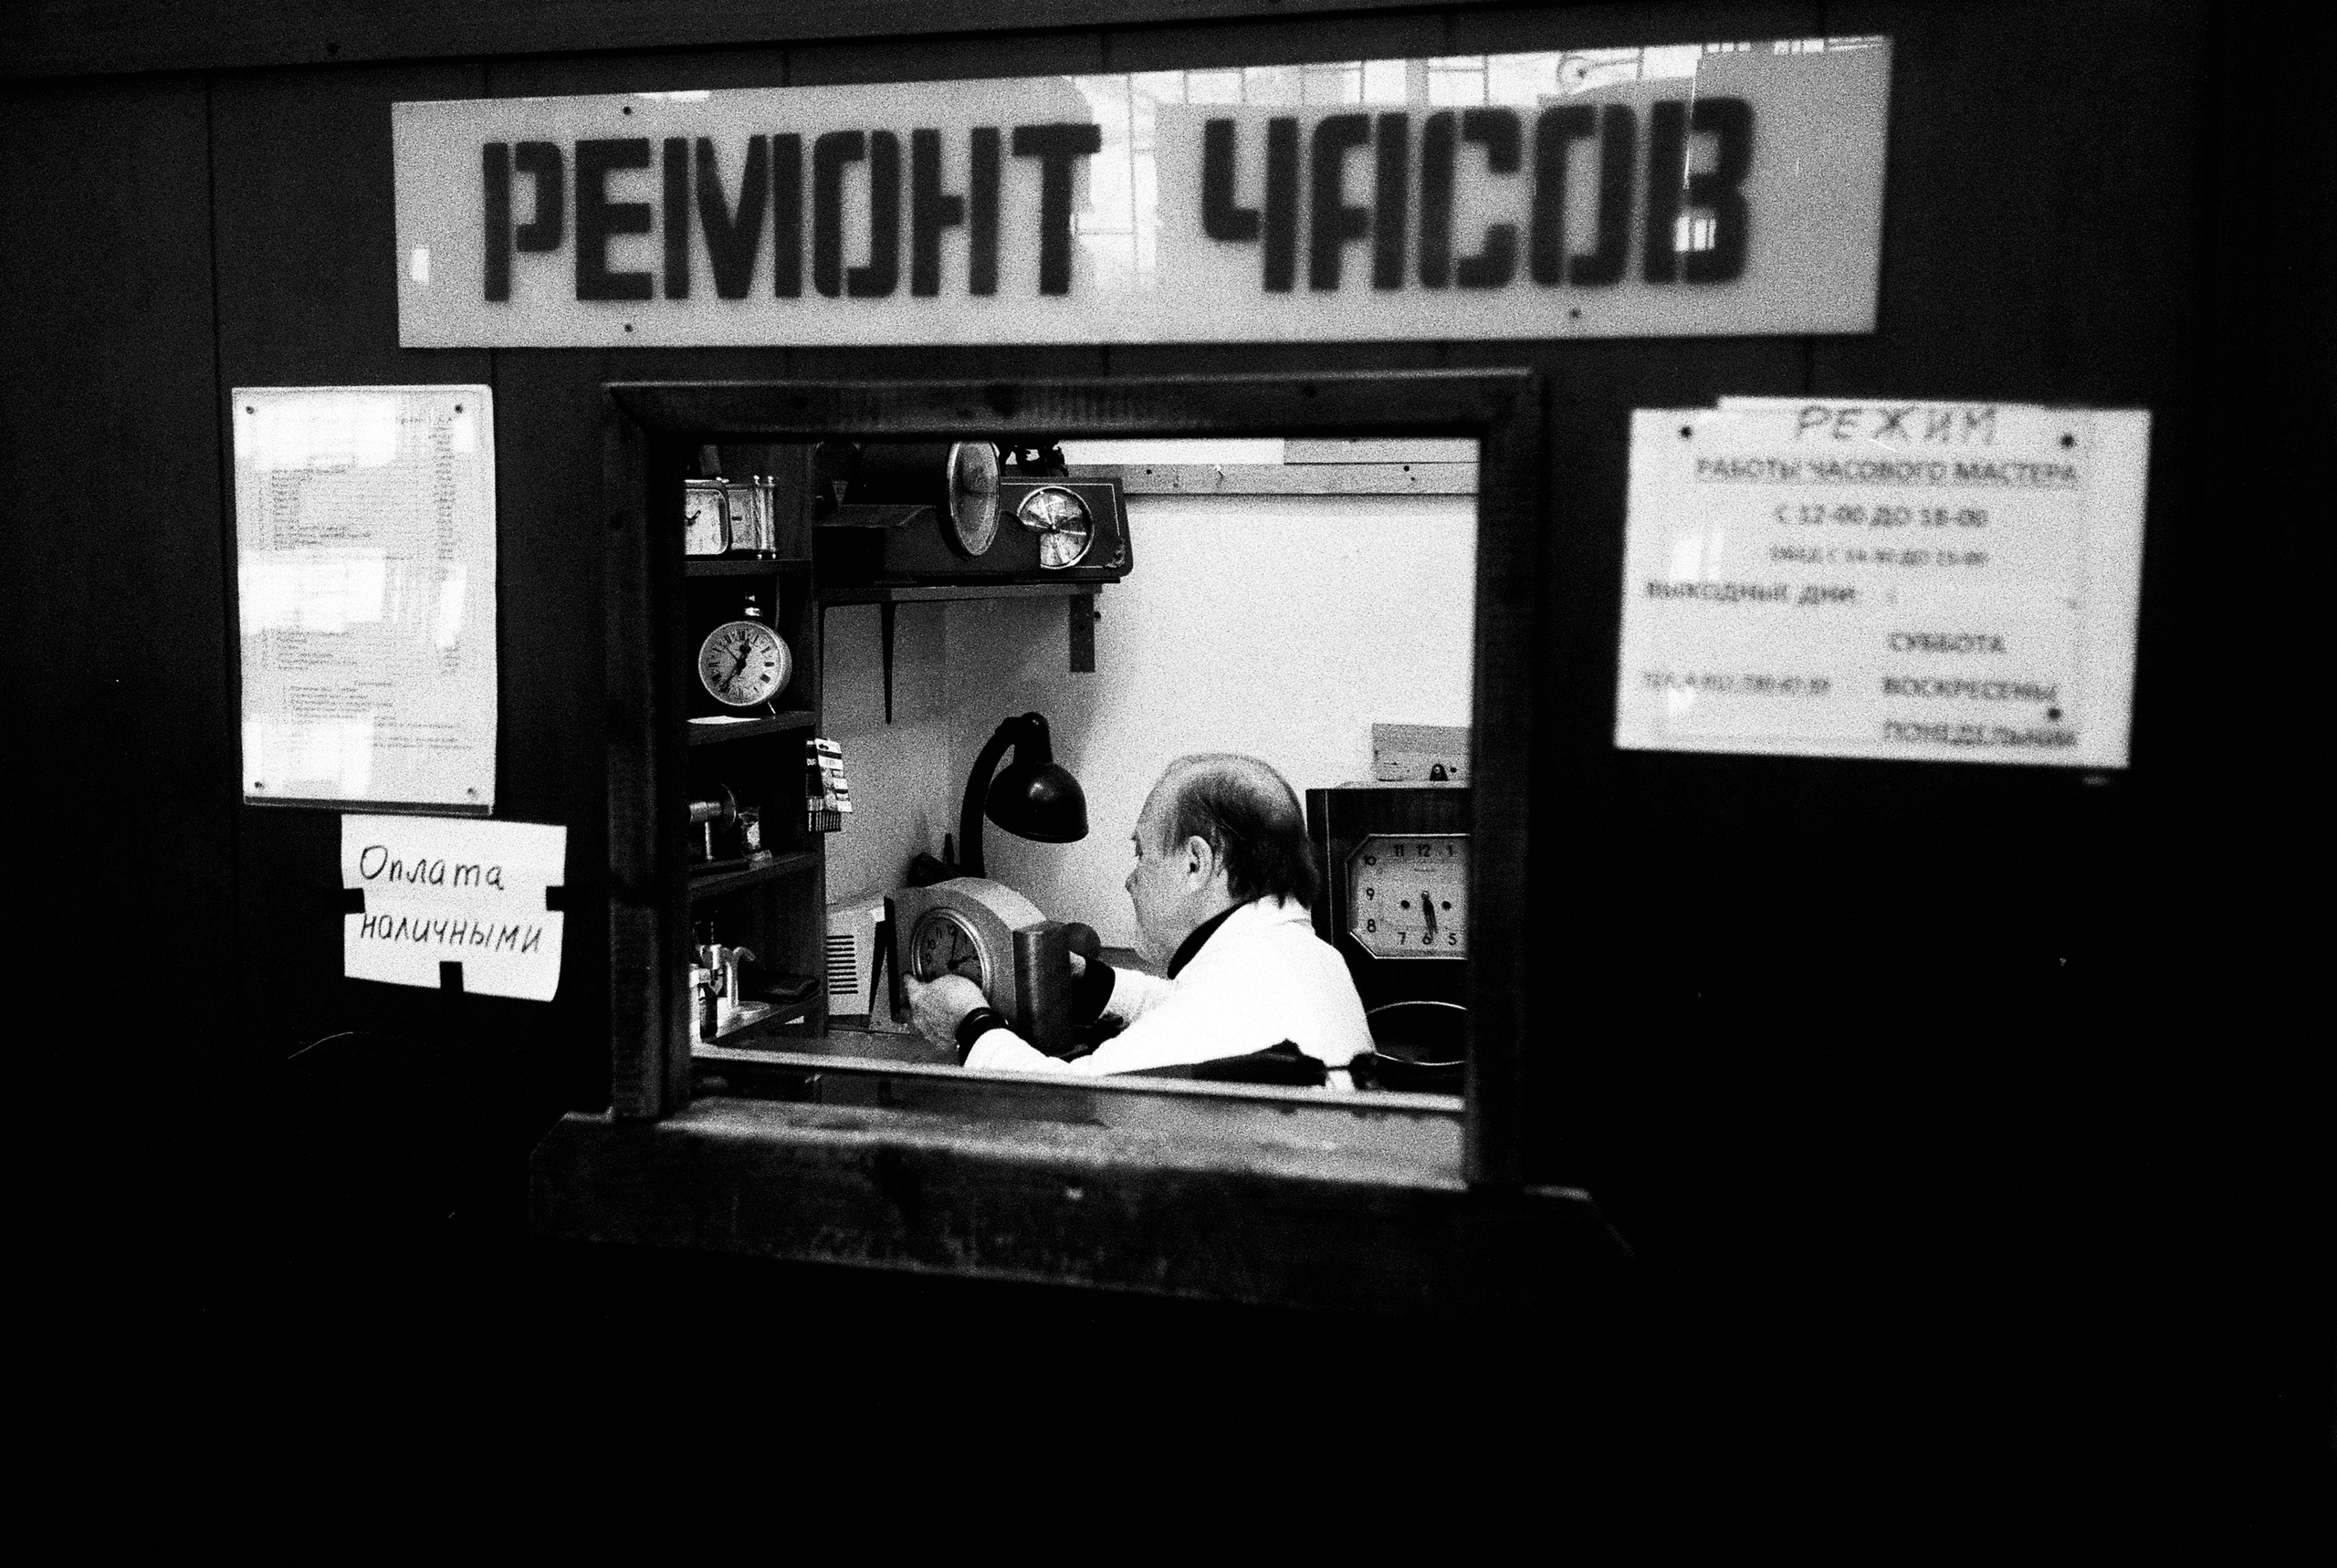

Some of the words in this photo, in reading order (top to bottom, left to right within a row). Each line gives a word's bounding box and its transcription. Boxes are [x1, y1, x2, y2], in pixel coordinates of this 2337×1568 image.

[482, 122, 1102, 302] РЕМОНТ
[1200, 96, 1756, 294] ЧАСОВ
[1797, 404, 1998, 444] РЕЖИМ
[1695, 457, 1800, 478] РАБОТЫ
[1807, 459, 1946, 482] ЧАСОВОГО
[1954, 461, 2078, 485] МАСТЕРА
[1869, 506, 1913, 528] ДО
[1888, 632, 2007, 654] СУББОТА
[1393, 844, 1404, 857] 11
[1416, 844, 1431, 857] 12
[360, 844, 505, 891] Оплата
[1367, 887, 1375, 901] 9
[360, 915, 543, 954] наличными
[1367, 918, 1376, 933] 8
[1398, 932, 1407, 945] 7
[1422, 932, 1431, 946] 6
[1448, 933, 1457, 946] 5
